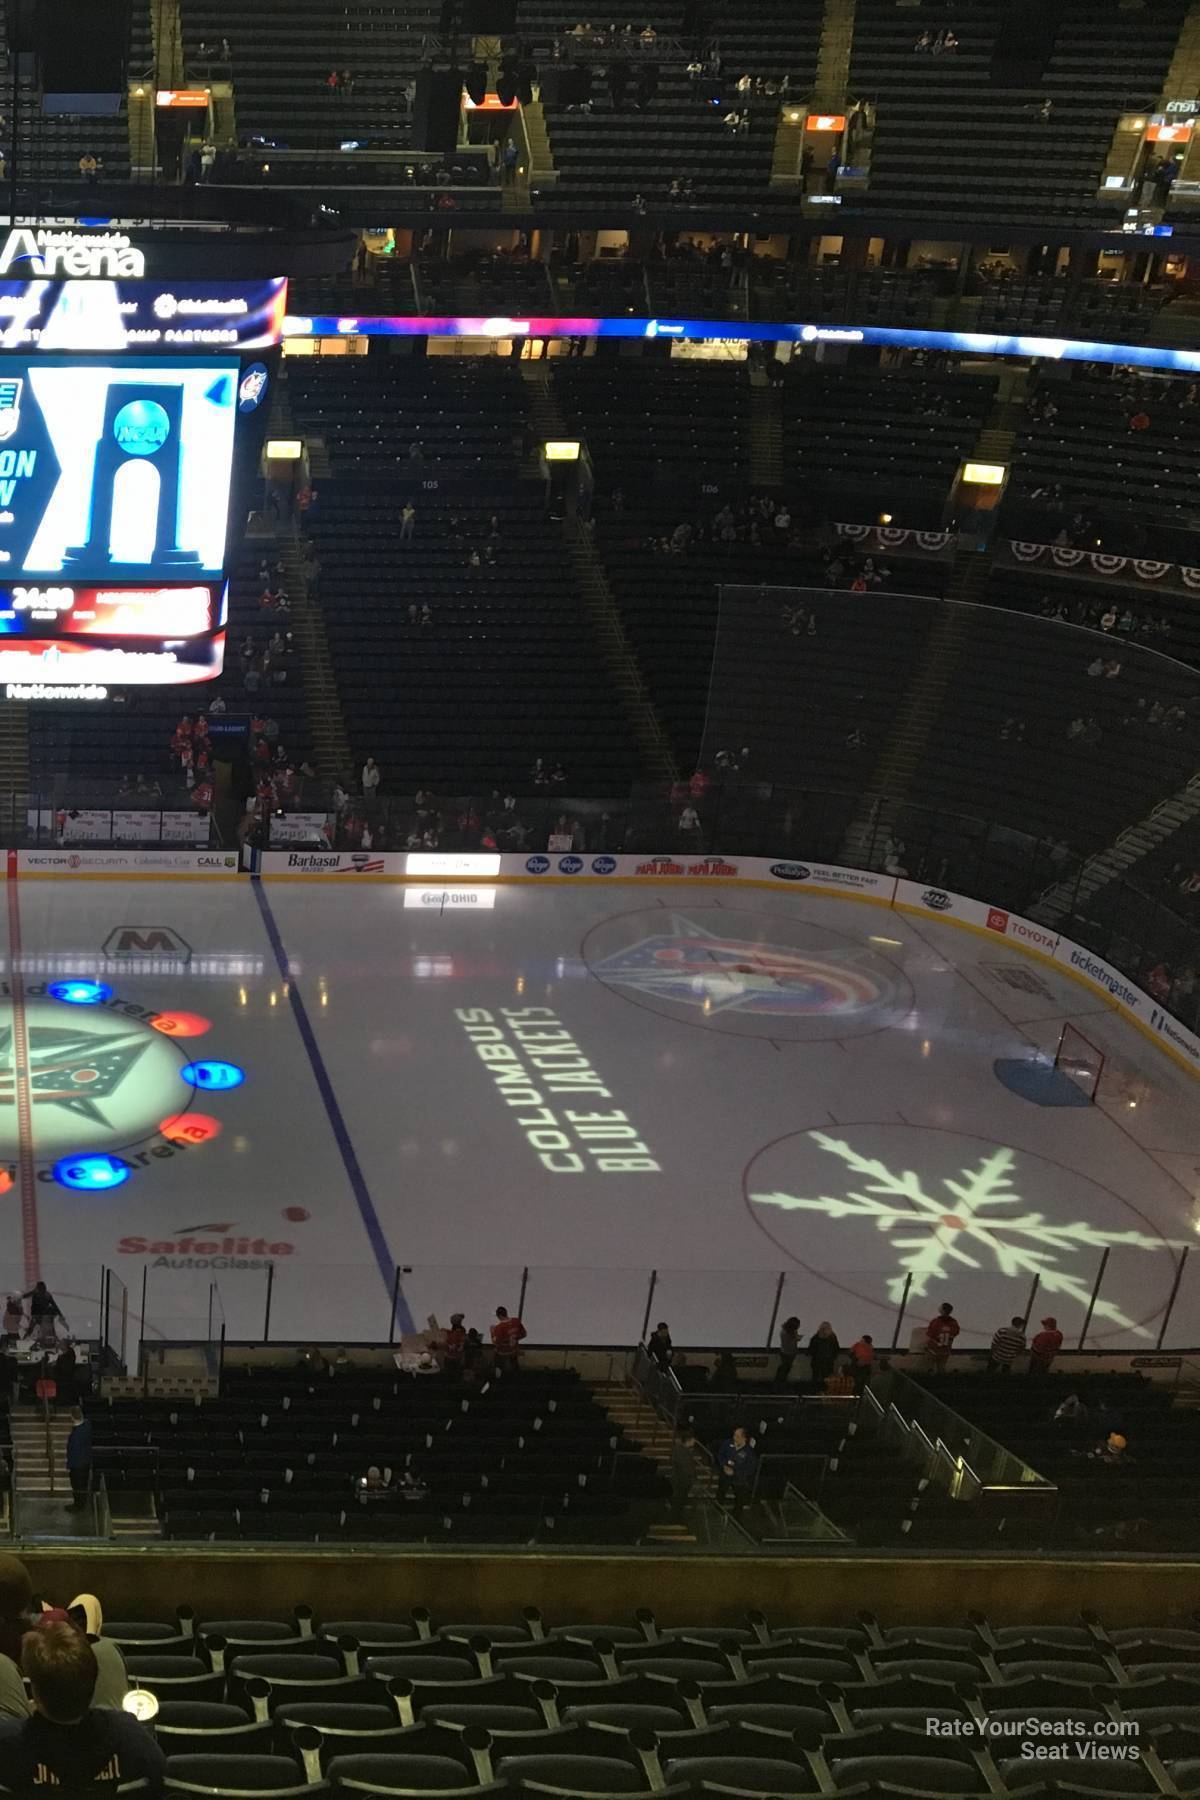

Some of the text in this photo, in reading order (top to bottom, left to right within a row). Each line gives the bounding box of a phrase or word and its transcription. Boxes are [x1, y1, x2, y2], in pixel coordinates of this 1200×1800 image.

[36, 230, 131, 249] Nationwide
[422, 480, 439, 490] 105
[701, 484, 719, 495] 106
[6, 683, 108, 701] Nationwide
[28, 857, 67, 865] VECTOR
[197, 857, 222, 865] CALL
[288, 853, 340, 867] Barbasol
[1011, 922, 1055, 948] TOYOTA
[1069, 949, 1139, 1007] ticketmaster
[454, 1007, 586, 1173] COLUMBUS
[500, 1007, 662, 1172] BLUE JACKETS
[116, 1236, 296, 1256] Safelite
[152, 1256, 276, 1270] AutoGlass
